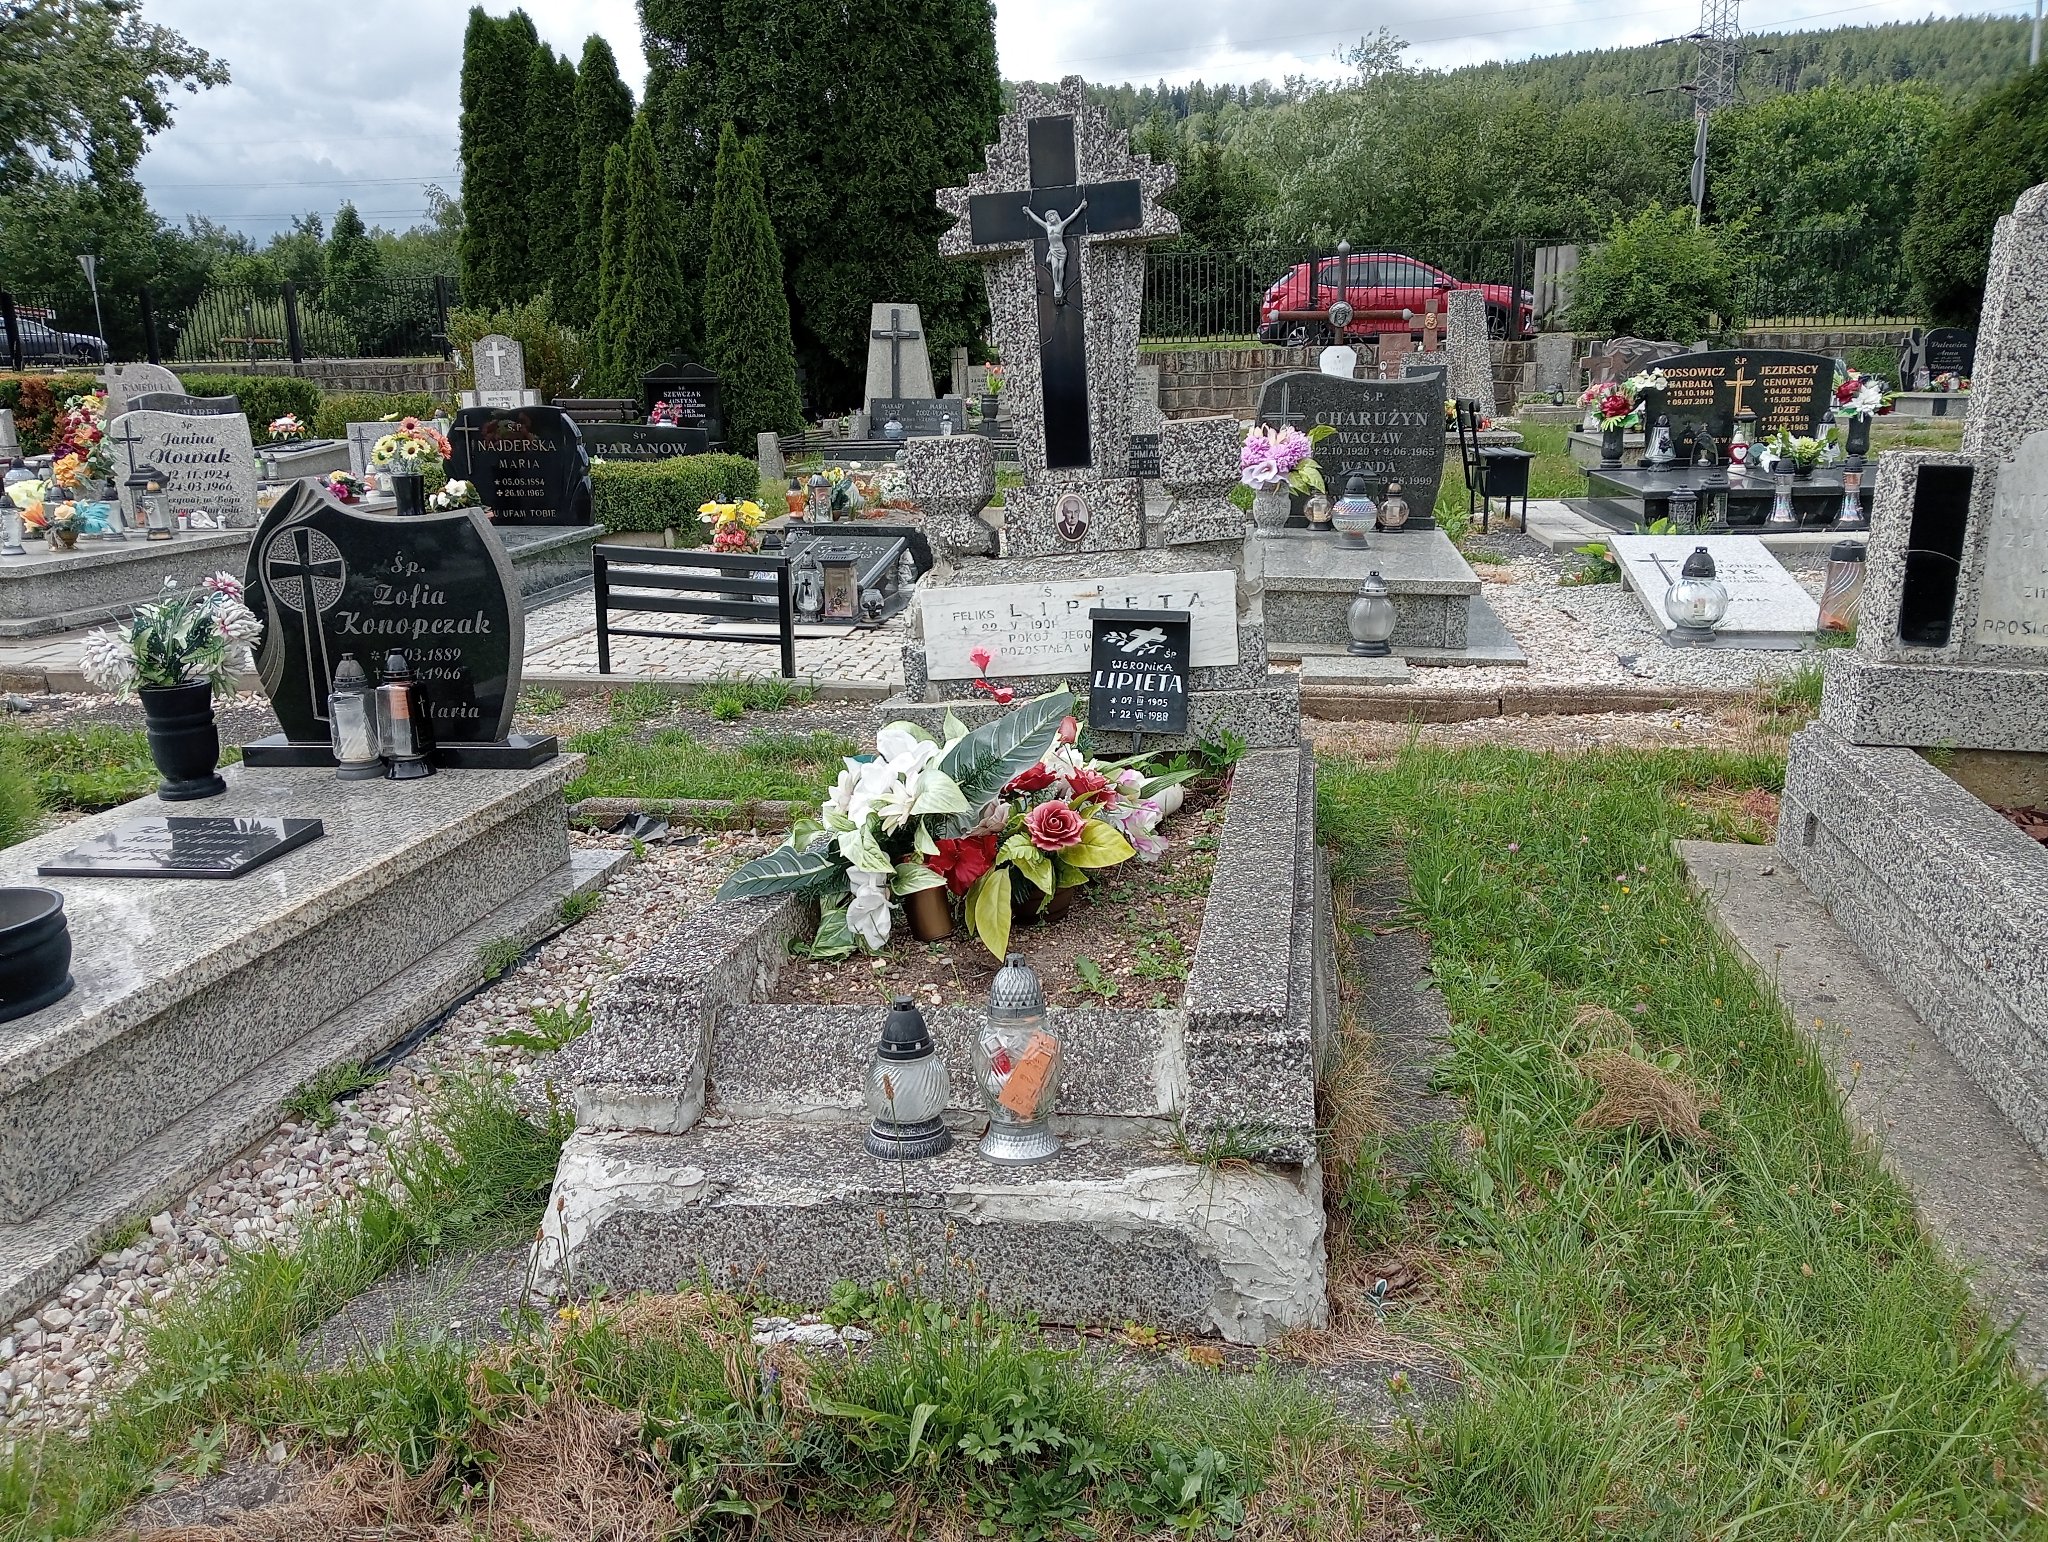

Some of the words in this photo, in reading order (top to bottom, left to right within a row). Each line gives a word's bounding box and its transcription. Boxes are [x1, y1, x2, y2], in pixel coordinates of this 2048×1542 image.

[1759, 365, 1819, 376] JEZIERSCY
[1669, 379, 1714, 388] BARBARA
[1763, 378, 1814, 387] GENOWEFA
[1673, 389, 1715, 397] 19.10.1949
[1672, 398, 1714, 406] 09.07.2019
[1771, 404, 1801, 414] JÓZEF
[1315, 408, 1430, 427] CHARUŻYN
[160, 432, 215, 447] Janina
[1338, 432, 1403, 445] WACŁAW
[477, 439, 558, 453] NAJDERSKA
[595, 442, 688, 455] BARANOW
[147, 447, 232, 464] Nowak
[499, 458, 541, 469] MARIA
[1341, 461, 1397, 473] WANDA
[503, 509, 527, 518] UFAM
[530, 509, 557, 518] TOBIE
[372, 583, 447, 609] Zofia
[952, 609, 996, 621] FELIKS
[334, 609, 492, 641] Konopczak
[1093, 670, 1183, 694] LIPIETA
